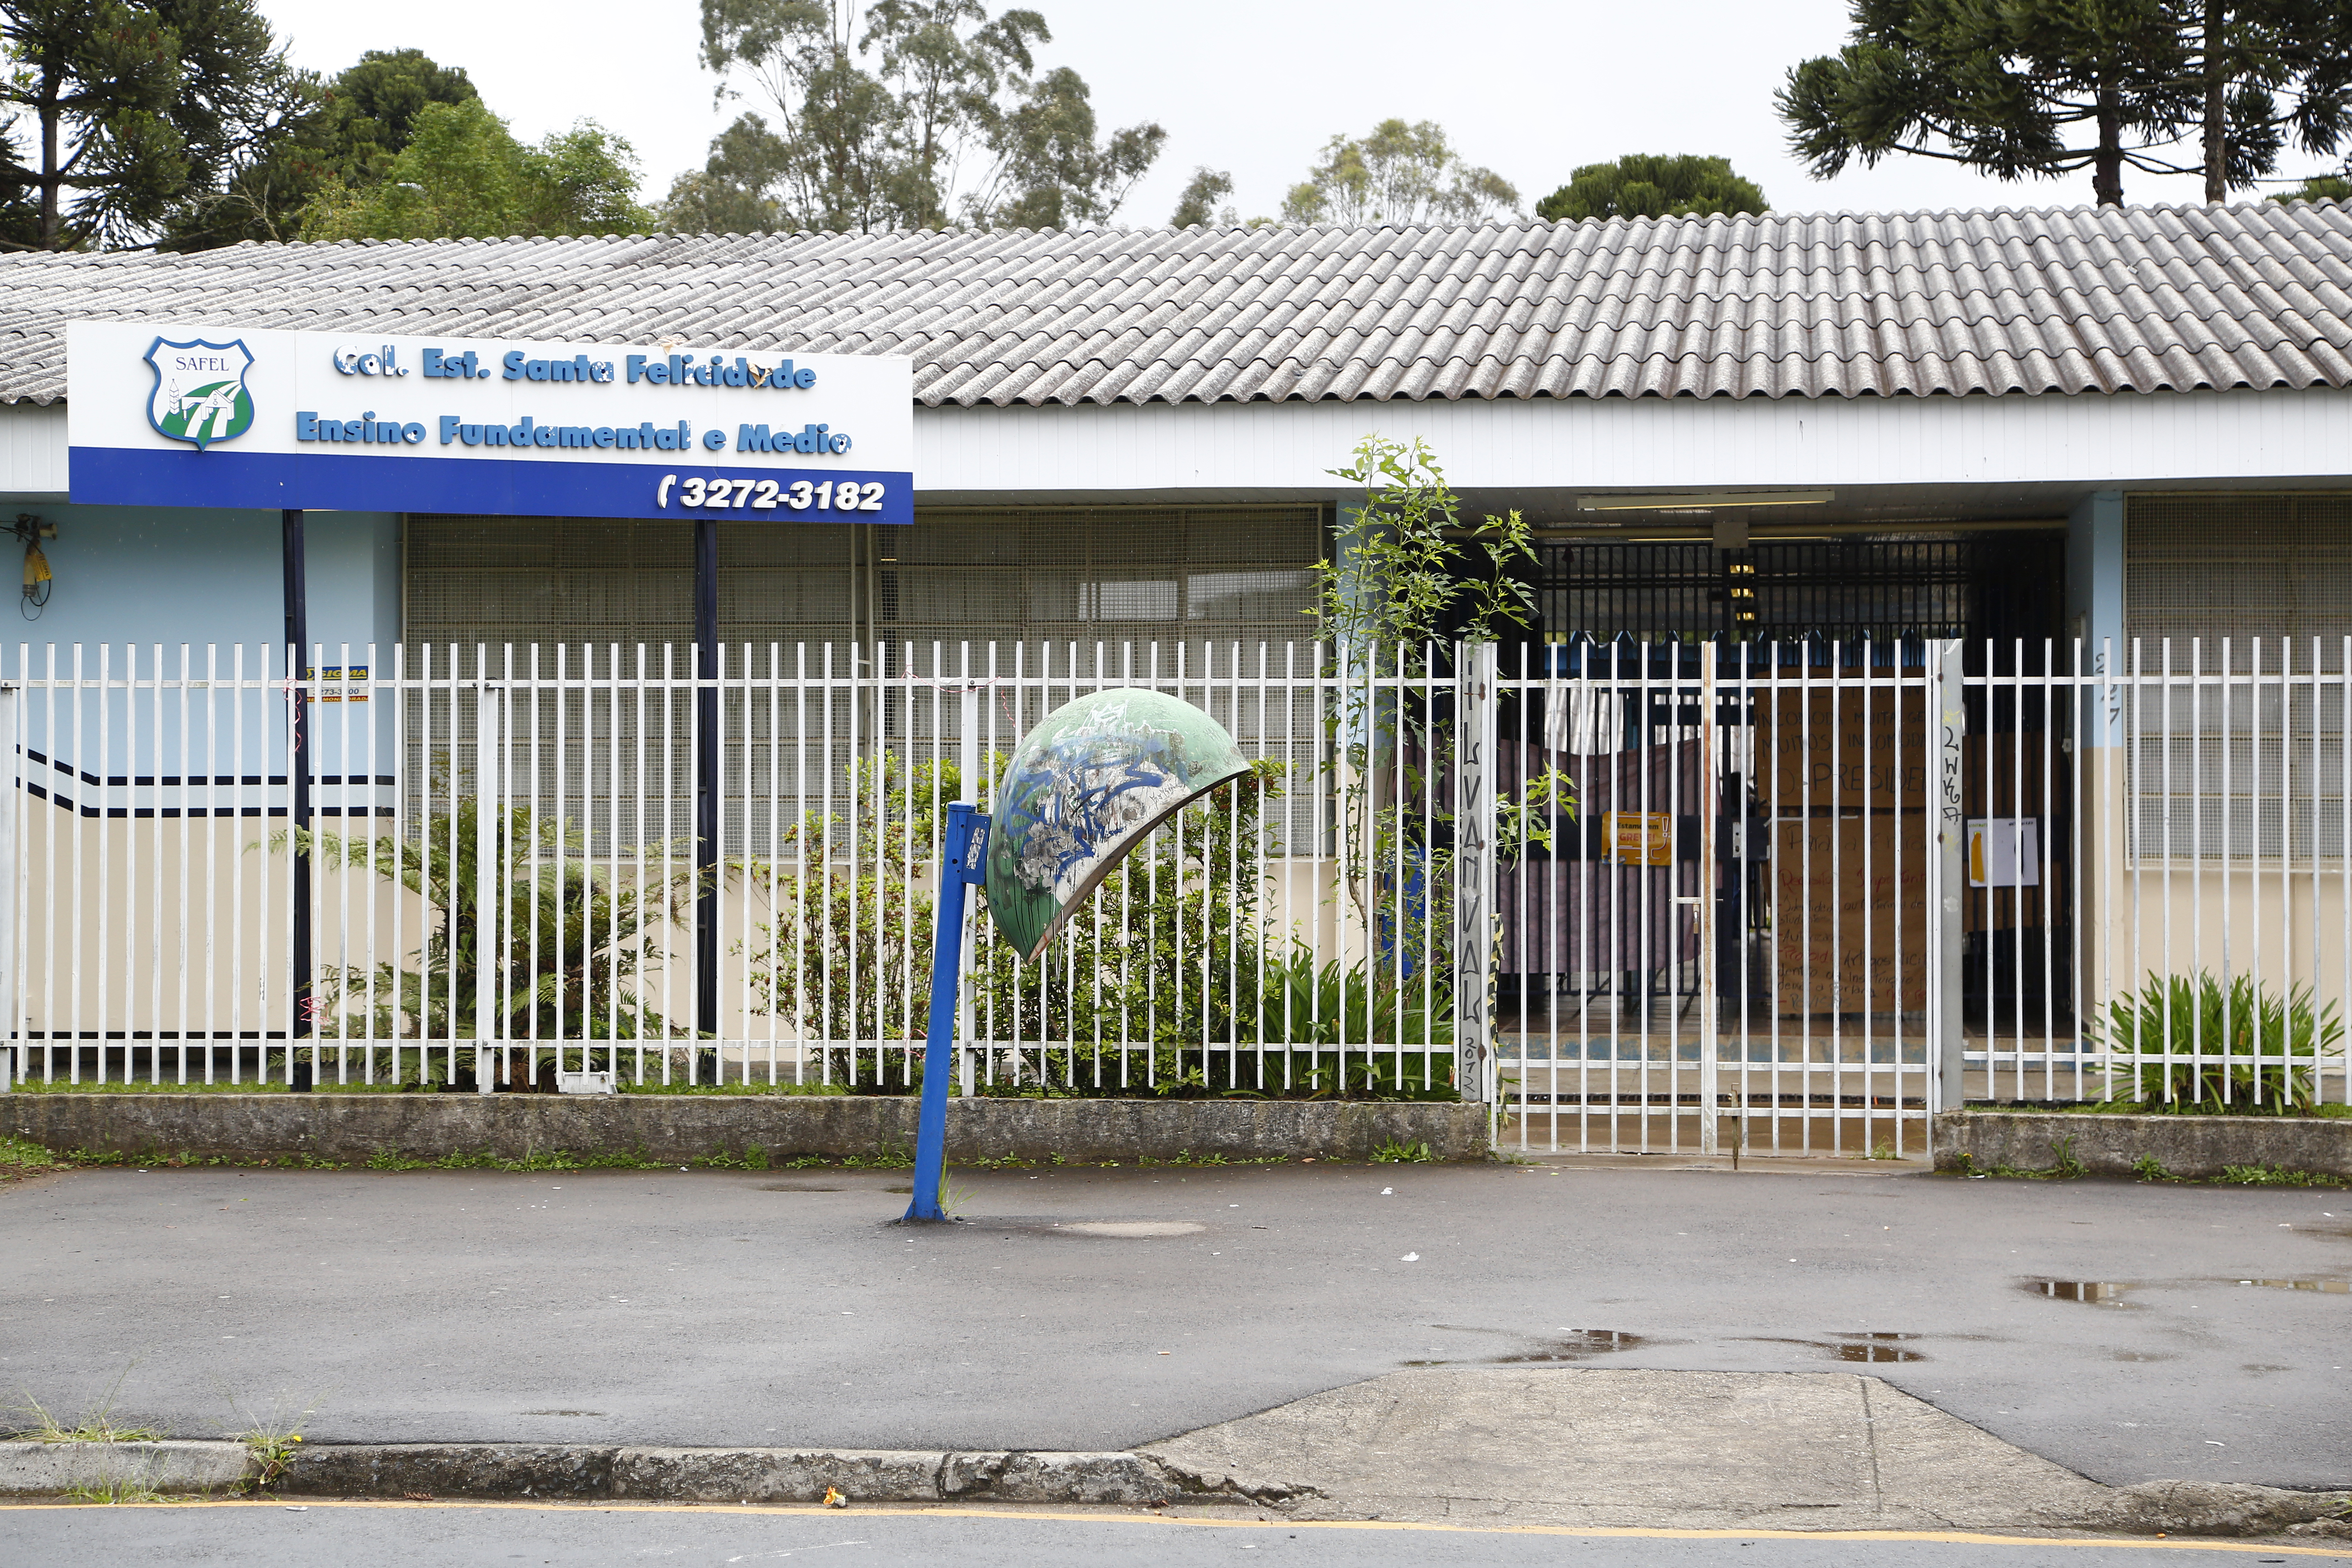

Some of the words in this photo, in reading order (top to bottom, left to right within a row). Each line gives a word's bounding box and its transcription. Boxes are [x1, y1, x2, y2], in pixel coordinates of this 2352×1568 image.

[175, 356, 230, 372] SAFEL
[334, 344, 409, 377] Col.
[422, 348, 491, 379] Est.
[503, 350, 615, 383] Santa
[626, 354, 816, 390] Felicidade
[296, 411, 426, 445] Ensino
[439, 415, 691, 450] Fundamental
[703, 428, 727, 451] e
[737, 423, 853, 455] Medio
[680, 477, 885, 512] 3272-3182
